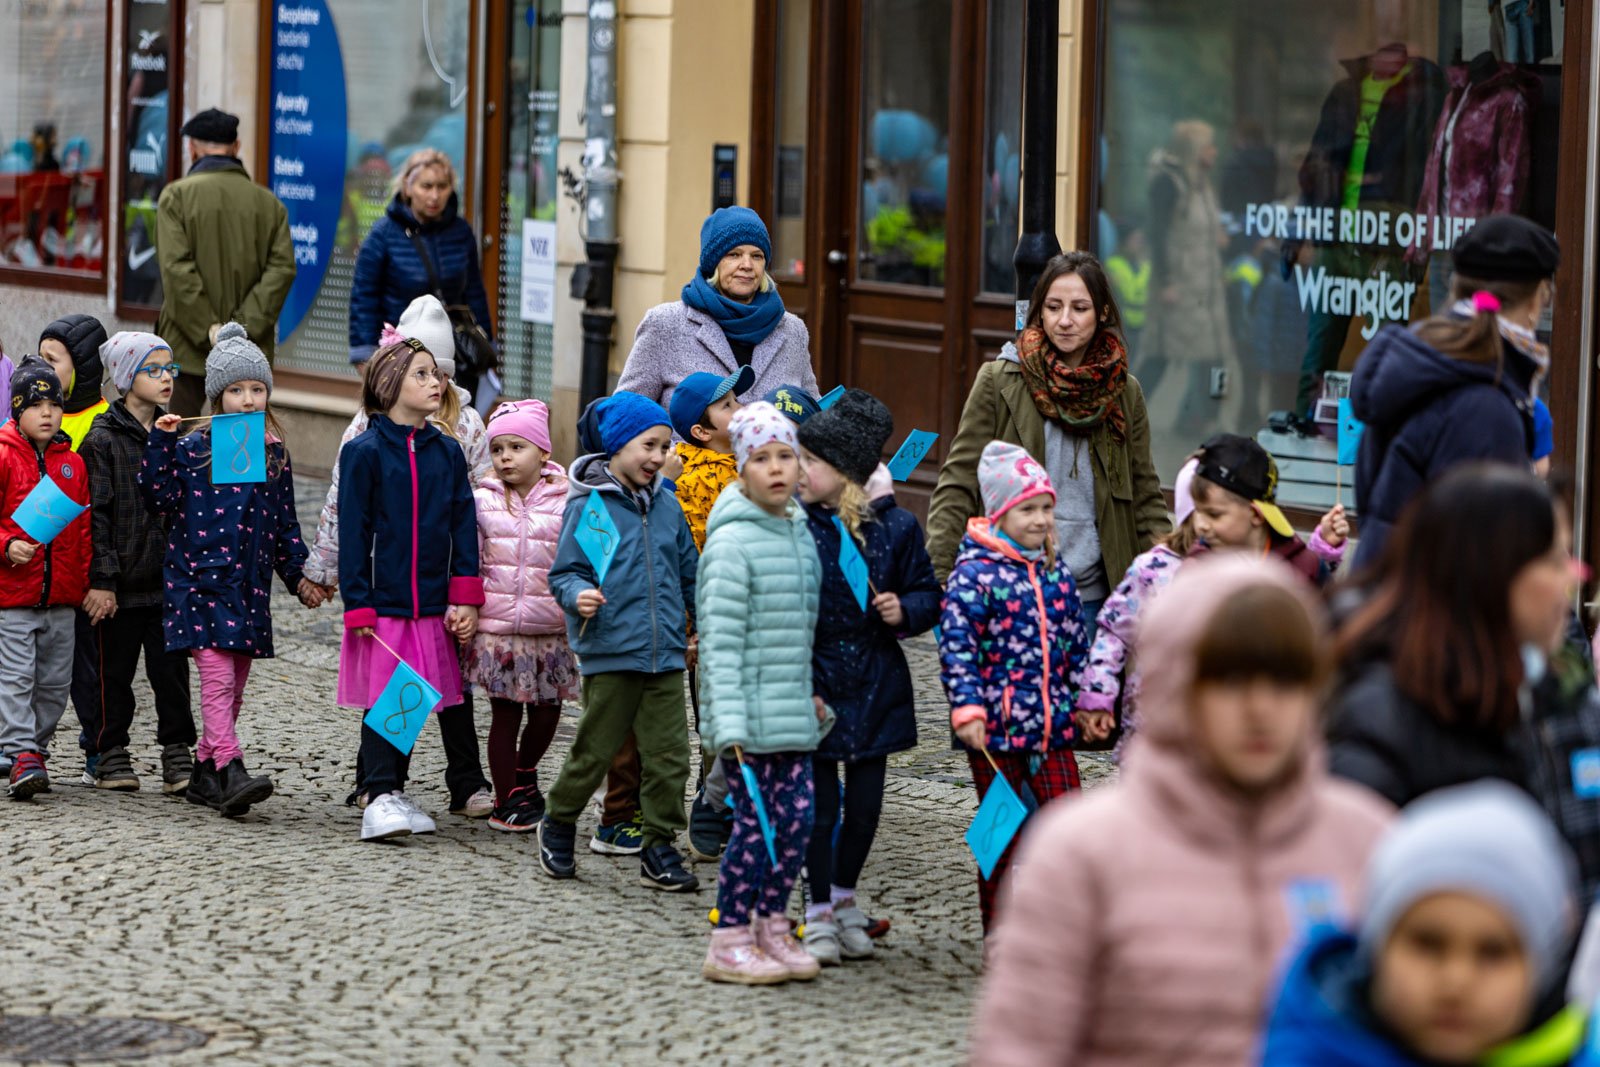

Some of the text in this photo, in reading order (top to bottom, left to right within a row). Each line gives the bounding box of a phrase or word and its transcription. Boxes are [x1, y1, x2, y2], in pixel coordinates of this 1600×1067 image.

[131, 54, 166, 71] Reebok
[1246, 203, 1288, 239] FOR
[1293, 206, 1333, 241] THE
[1339, 208, 1390, 245] RIDE
[1395, 212, 1427, 249] OF
[1294, 263, 1415, 341] Wrangler
